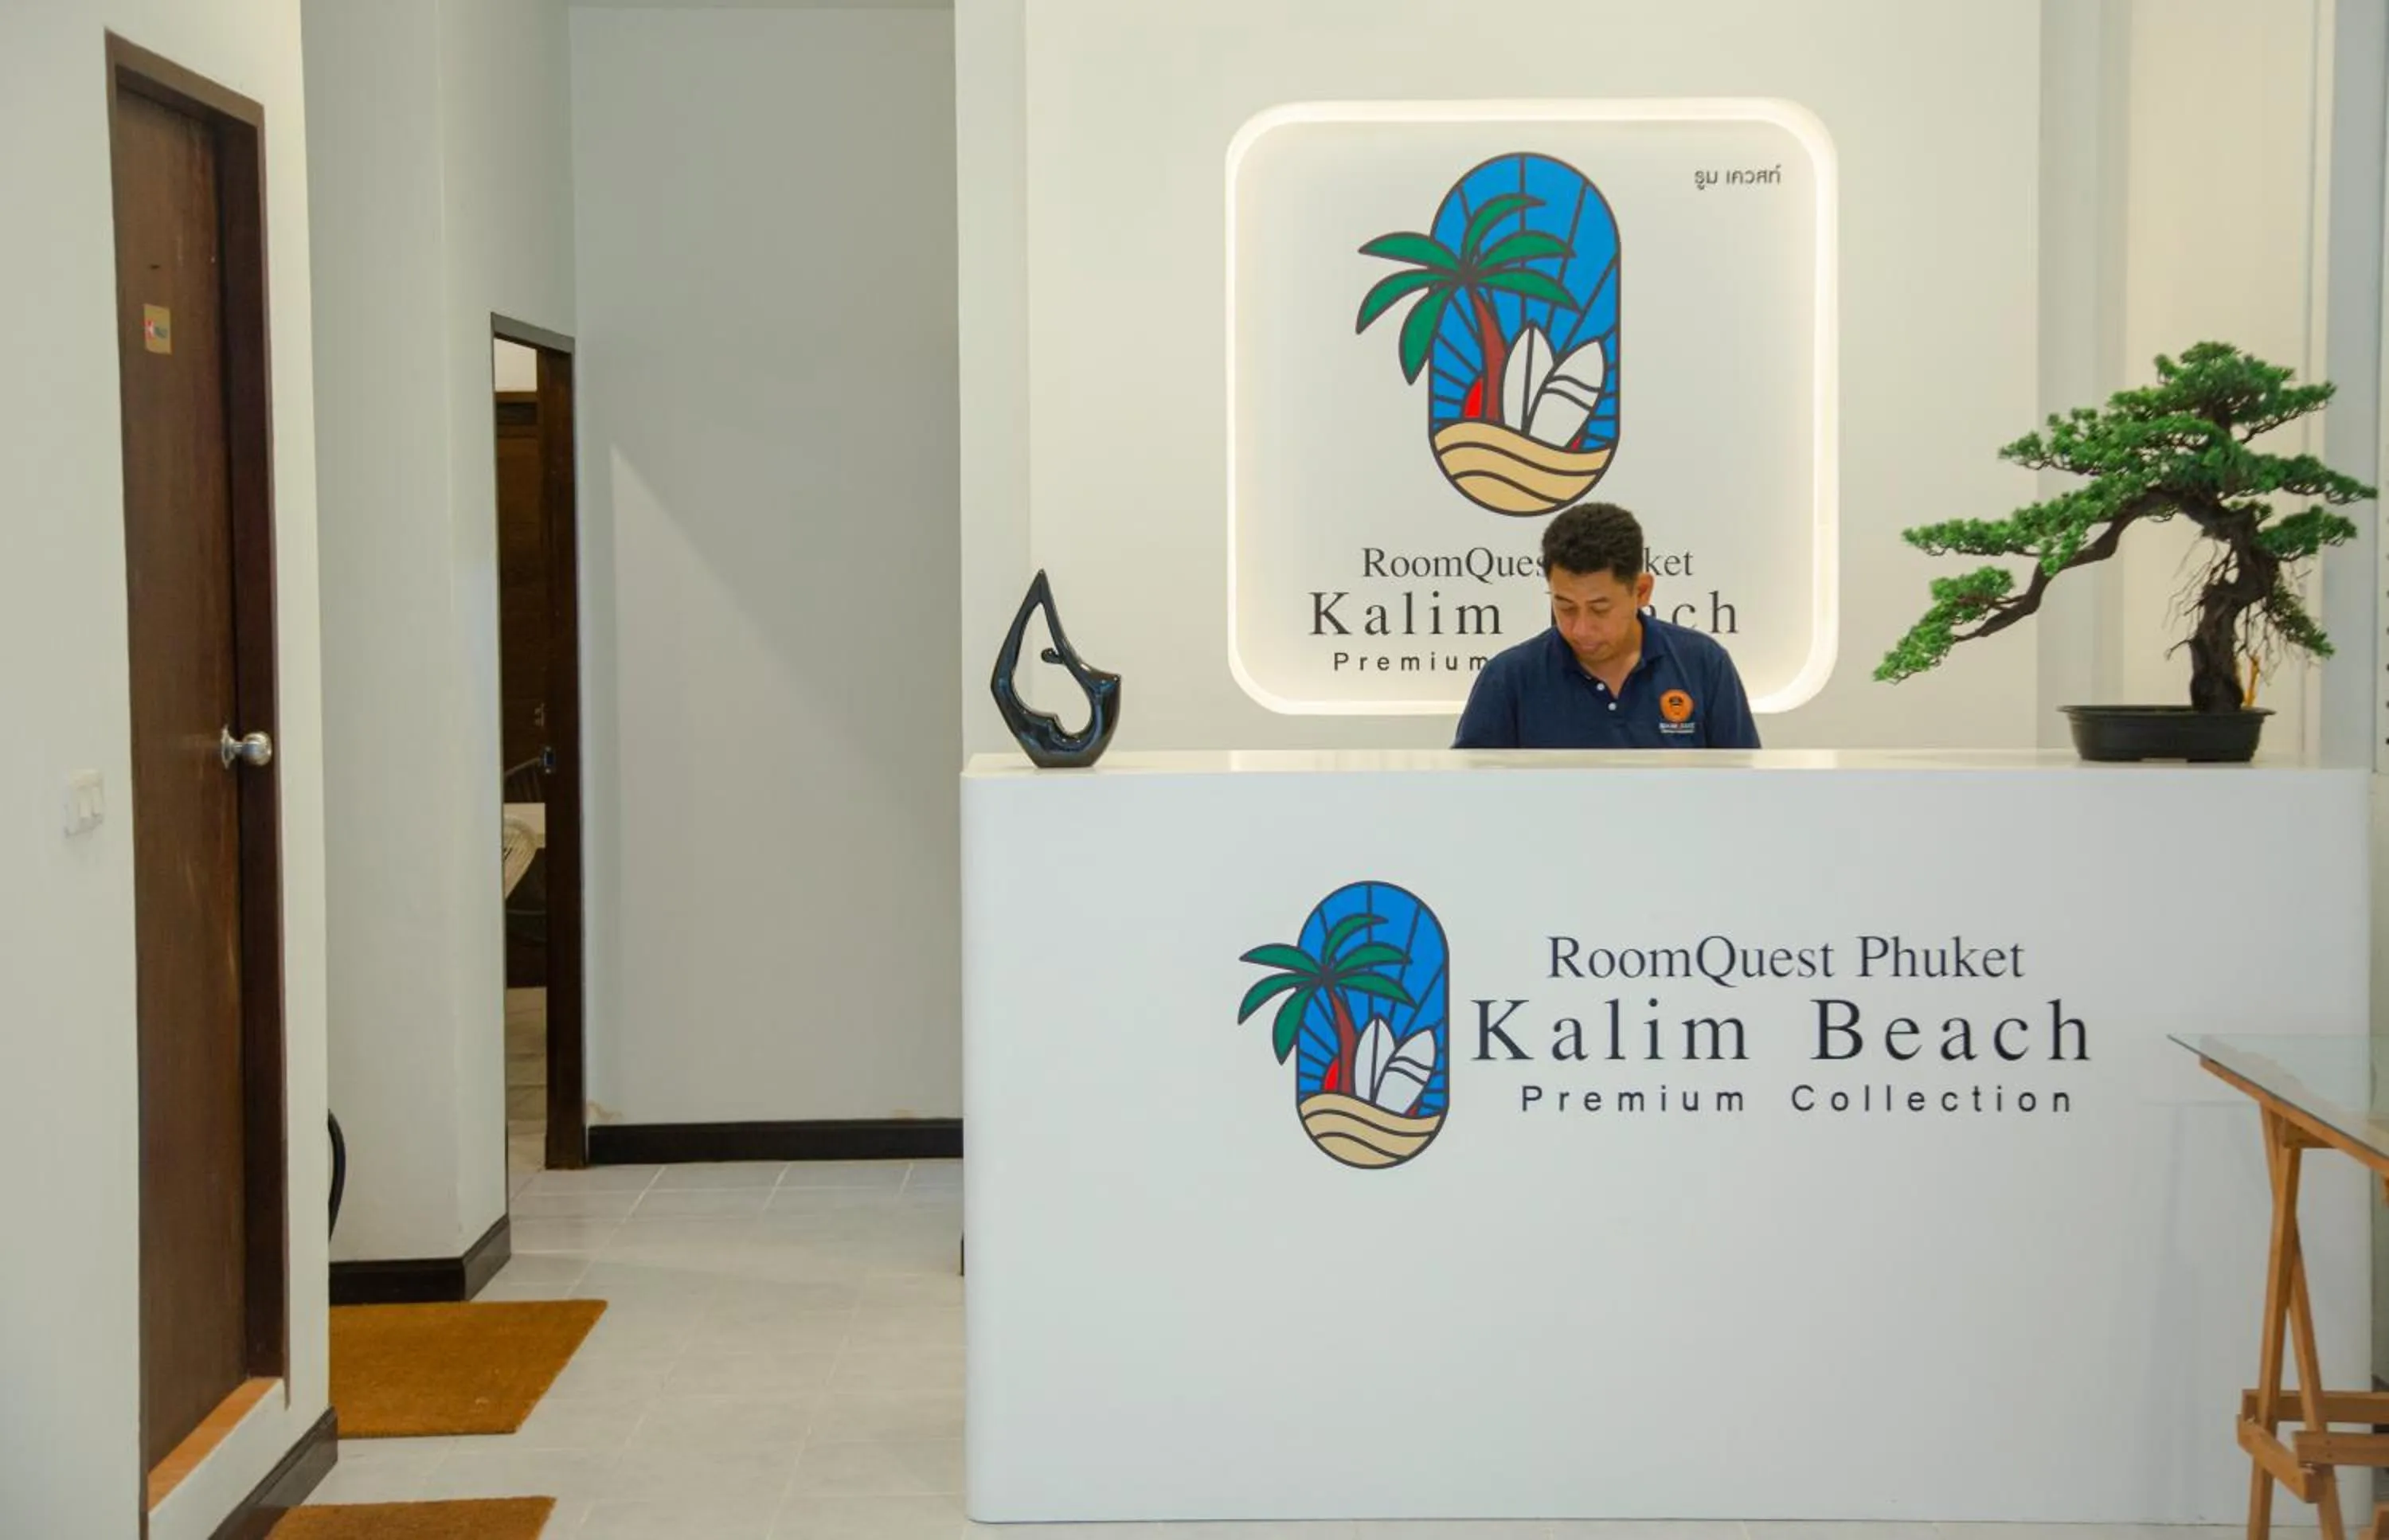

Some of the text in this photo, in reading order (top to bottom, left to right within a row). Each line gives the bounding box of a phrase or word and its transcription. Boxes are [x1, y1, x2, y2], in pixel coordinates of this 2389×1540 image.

[1363, 546, 1694, 584] RoomQues ket
[1309, 590, 1504, 636] Kalim
[1334, 651, 1488, 671] Premium
[1547, 935, 2025, 988] RoomQuest Phuket
[1471, 997, 2091, 1061] Kalim Beach
[1522, 1084, 2071, 1113] Premium Collection
